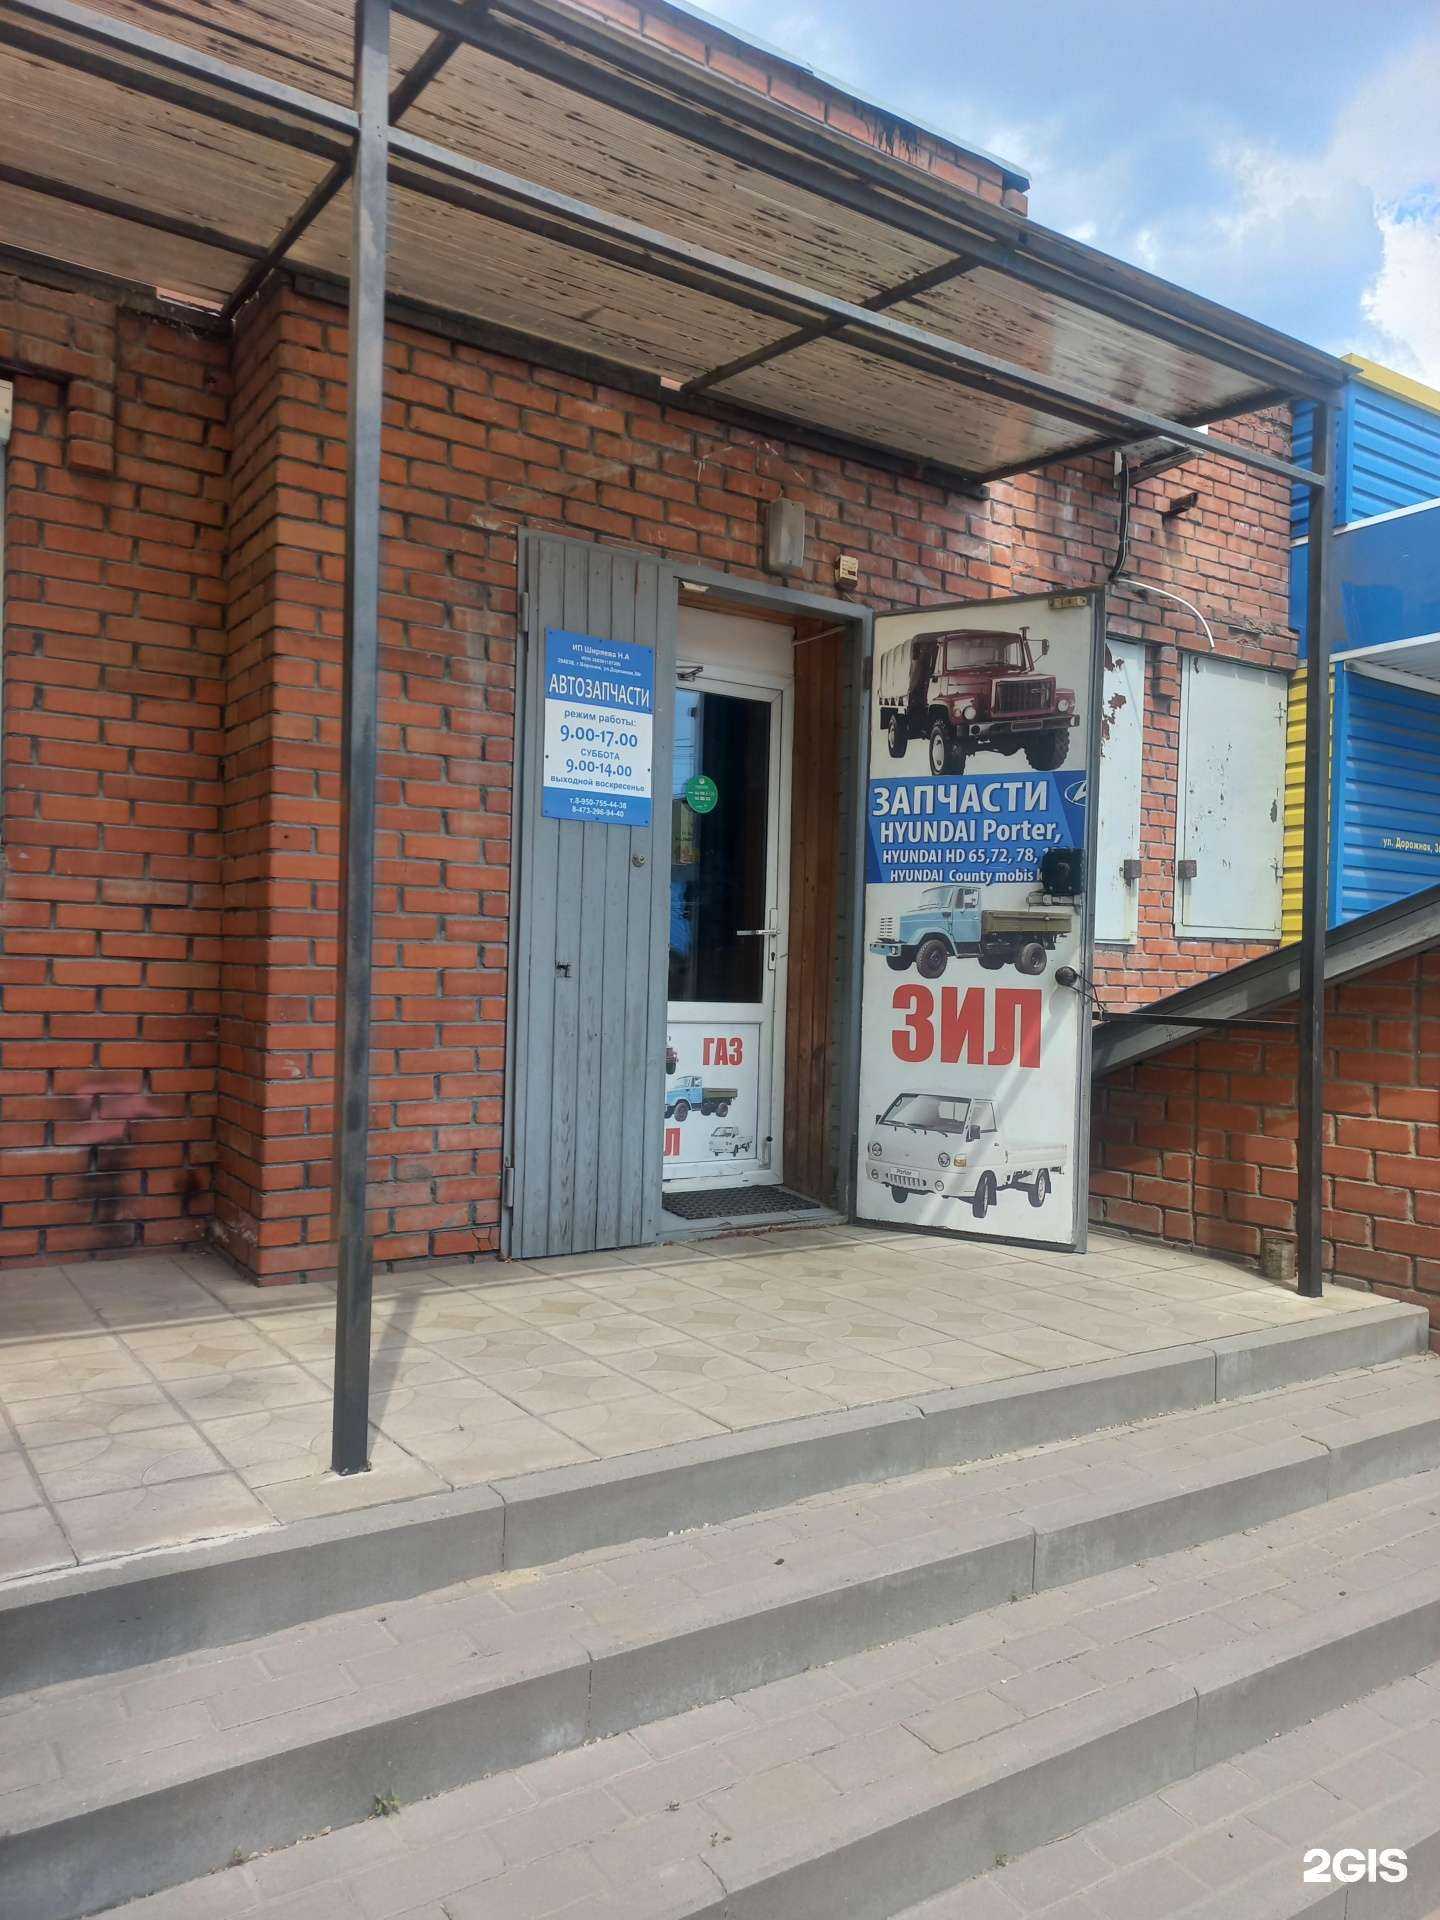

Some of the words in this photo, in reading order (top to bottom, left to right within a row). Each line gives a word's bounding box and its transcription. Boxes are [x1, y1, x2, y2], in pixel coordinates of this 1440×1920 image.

[572, 643, 583, 652] ИП
[549, 673, 650, 708] АВТОЗАПЧАСТИ
[564, 710, 596, 720] режим
[599, 714, 636, 726] работы:
[560, 725, 638, 747] 9.00-17.00
[580, 748, 620, 760] СУББОТА
[566, 759, 632, 777] 9.00-14.00
[550, 775, 593, 787] выходной
[872, 780, 1048, 817] ЗАПЧАСТИ
[880, 819, 976, 844] HYUNDAI
[983, 819, 1062, 844] Porter,
[1383, 837, 1393, 849] ул.
[1395, 837, 1433, 853] Дорожная,
[882, 849, 942, 864] HYUNDAI
[945, 848, 966, 863] HD
[1016, 847, 1039, 864] 78,
[890, 869, 944, 882] HYUNDAI
[949, 868, 992, 886] County
[995, 868, 1034, 882] mobis
[891, 983, 1042, 1068] ЗИЛ
[703, 1037, 744, 1066] ГАЗ
